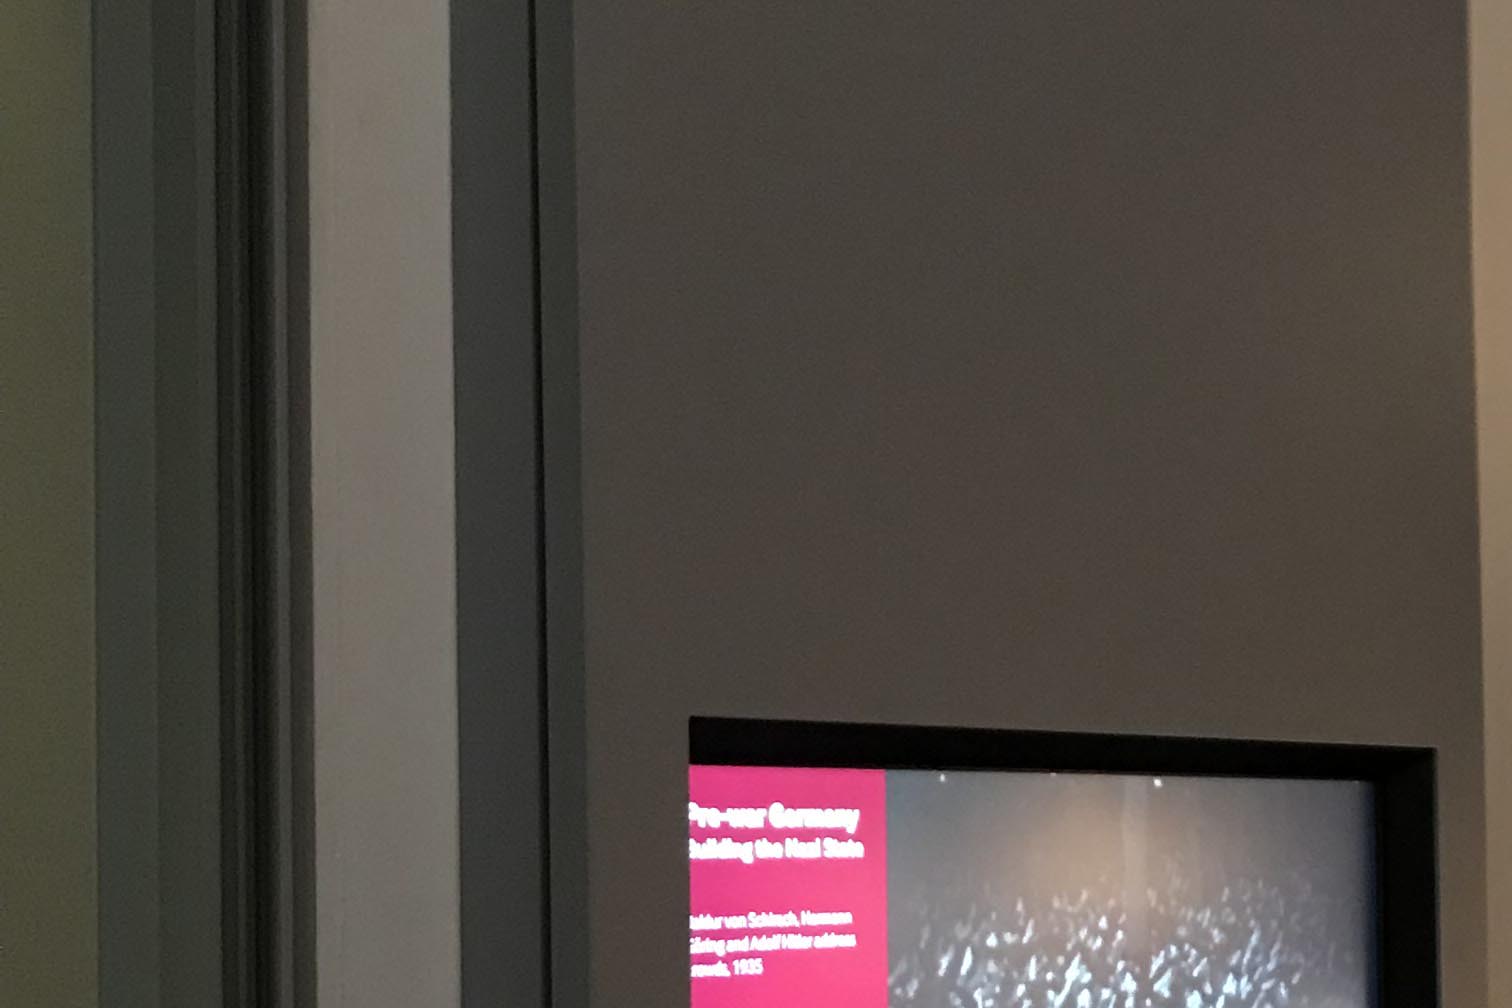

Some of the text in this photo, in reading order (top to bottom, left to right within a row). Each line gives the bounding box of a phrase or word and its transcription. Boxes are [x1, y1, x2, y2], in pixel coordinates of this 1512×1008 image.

[769, 802, 860, 834] Germany
[754, 838, 783, 858] the
[690, 936, 726, 957] öring
